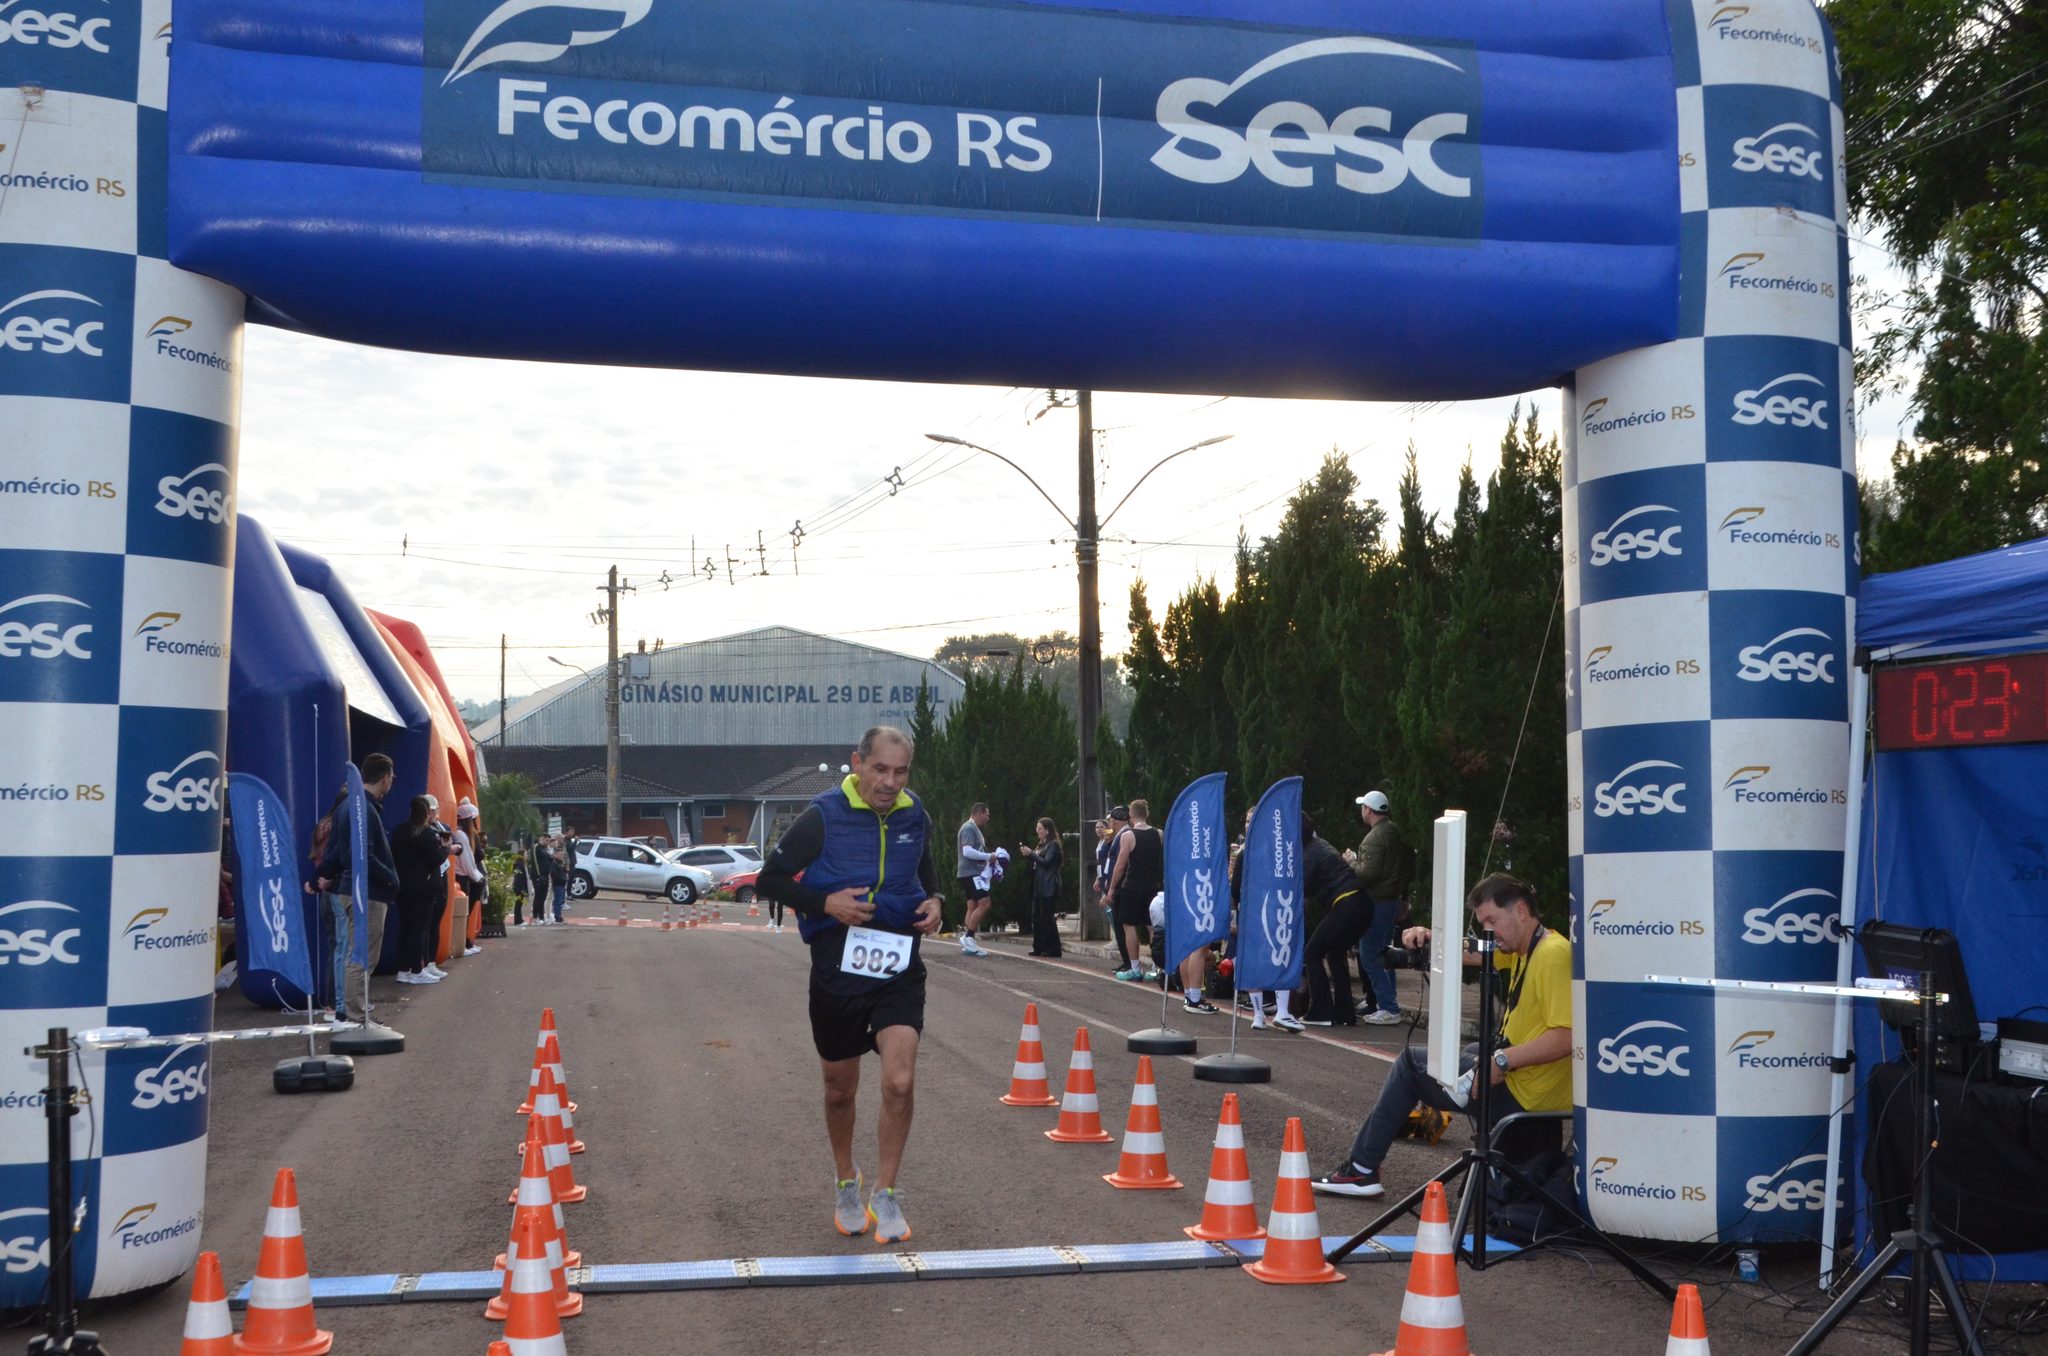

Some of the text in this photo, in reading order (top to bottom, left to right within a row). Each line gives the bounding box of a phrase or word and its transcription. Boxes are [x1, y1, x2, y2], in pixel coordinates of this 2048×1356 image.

[1720, 27, 1823, 54] Fecomércio RS
[498, 78, 1053, 172] Fecomércio RS
[1150, 77, 1471, 197] Sesc
[1731, 137, 1823, 181] Sesc
[96, 178, 126, 198] RS
[1729, 275, 1835, 299] Fecomércio RS
[0, 316, 104, 357] esc
[158, 339, 233, 373] Fecomércio
[1586, 404, 1696, 436] Fecomércio RS
[1731, 389, 1828, 430] Sesc
[87, 480, 117, 499] RS
[155, 476, 233, 527] Sesc
[1590, 525, 1682, 567] Sesc
[1731, 529, 1821, 546] Fecomércio
[1825, 533, 1840, 549] RS
[146, 636, 221, 659] Fecomércio
[1736, 645, 1834, 684] Sesc
[1589, 662, 1670, 683] Fecomércio
[1676, 659, 1700, 675] RS
[621, 680, 703, 703] GINÁSIO
[710, 685, 820, 703] MUNICIPAL
[827, 685, 852, 703] 29
[859, 686, 883, 703] DE
[76, 784, 105, 802] RS
[143, 771, 219, 812] Sesc
[1594, 782, 1686, 818] Sesc
[1735, 787, 1846, 805] Fecomércio RS
[257, 799, 272, 868] Fecomércio
[1188, 800, 1200, 859] Fecomércio
[1273, 809, 1284, 878] Fecomércio
[269, 877, 288, 953] Sesc
[1195, 868, 1215, 933] Sesc
[134, 929, 208, 950] Fecomércio
[1271, 890, 1294, 968] Sesc
[1593, 920, 1674, 936] Fecomércio
[1680, 920, 1705, 935] RS
[1741, 907, 1840, 945] Sesc
[851, 945, 900, 975] 982
[1597, 1037, 1690, 1077] Sesc
[131, 1060, 208, 1110] Sesc
[1595, 1177, 1676, 1201] Fecomércio
[1682, 1186, 1707, 1201] RS
[122, 1216, 196, 1250] Fecomércio
